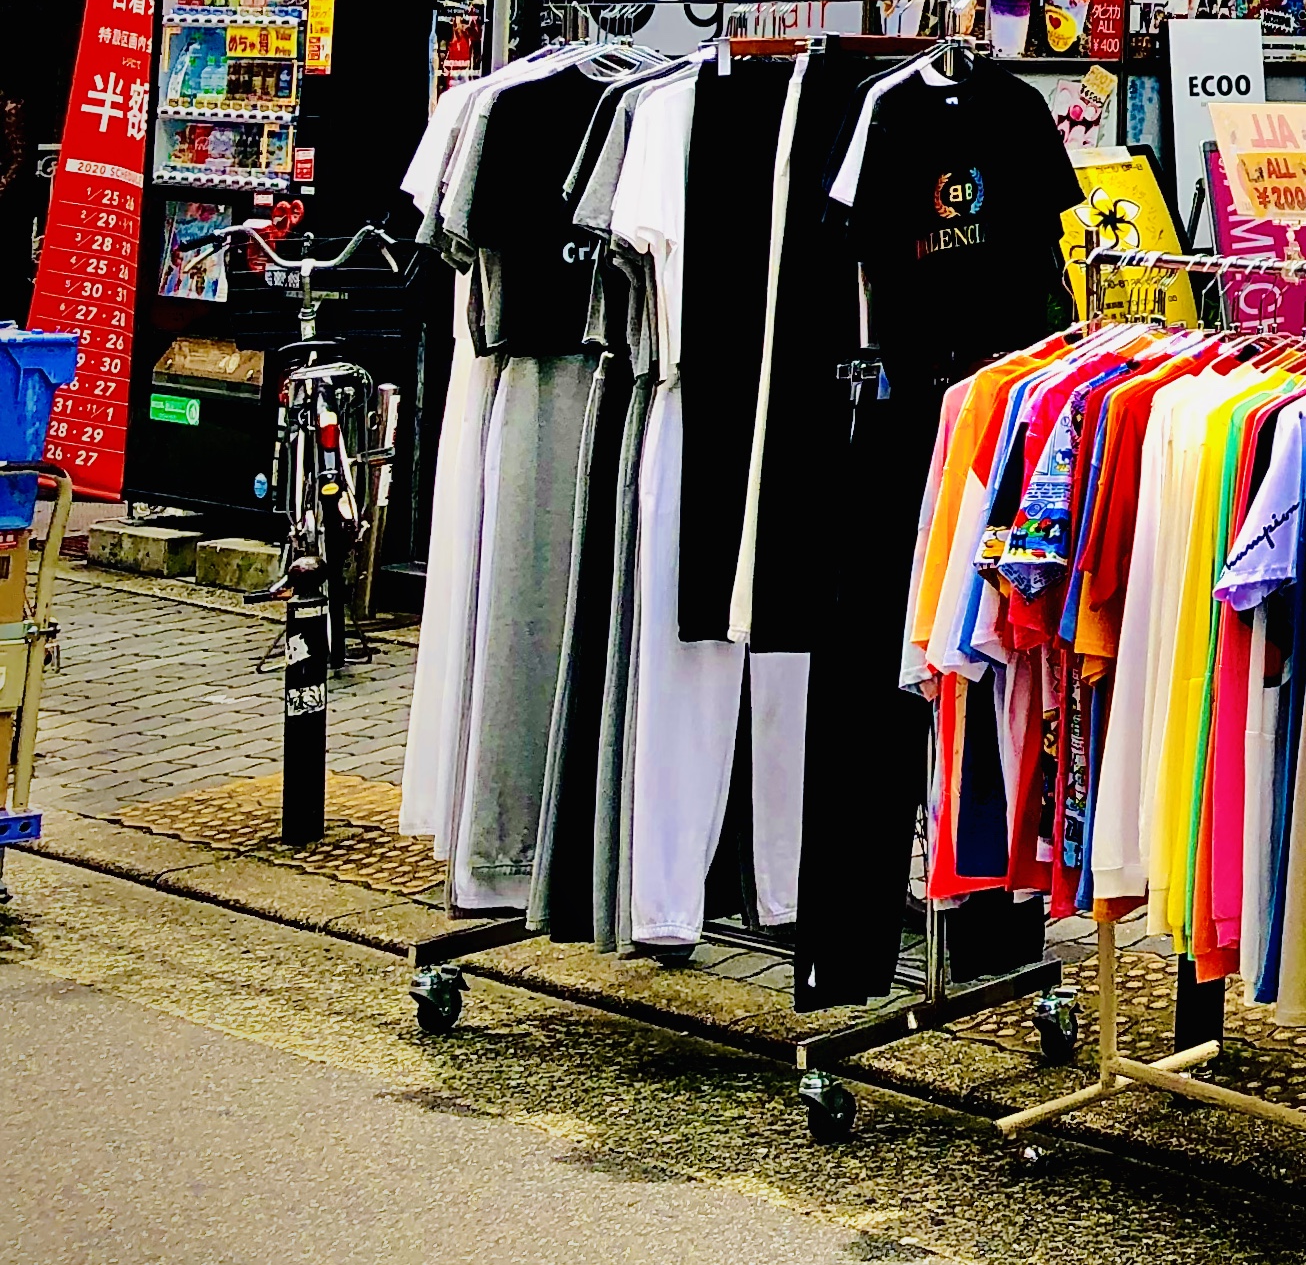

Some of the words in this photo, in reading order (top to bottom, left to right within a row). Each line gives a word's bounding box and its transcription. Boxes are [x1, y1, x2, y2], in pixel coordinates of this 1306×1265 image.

[1096, 20, 1116, 34] ALL
[1093, 38, 1120, 53] ¥400
[1188, 74, 1251, 97] ECOO
[77, 161, 107, 176] 2020
[1266, 157, 1297, 179] ALL
